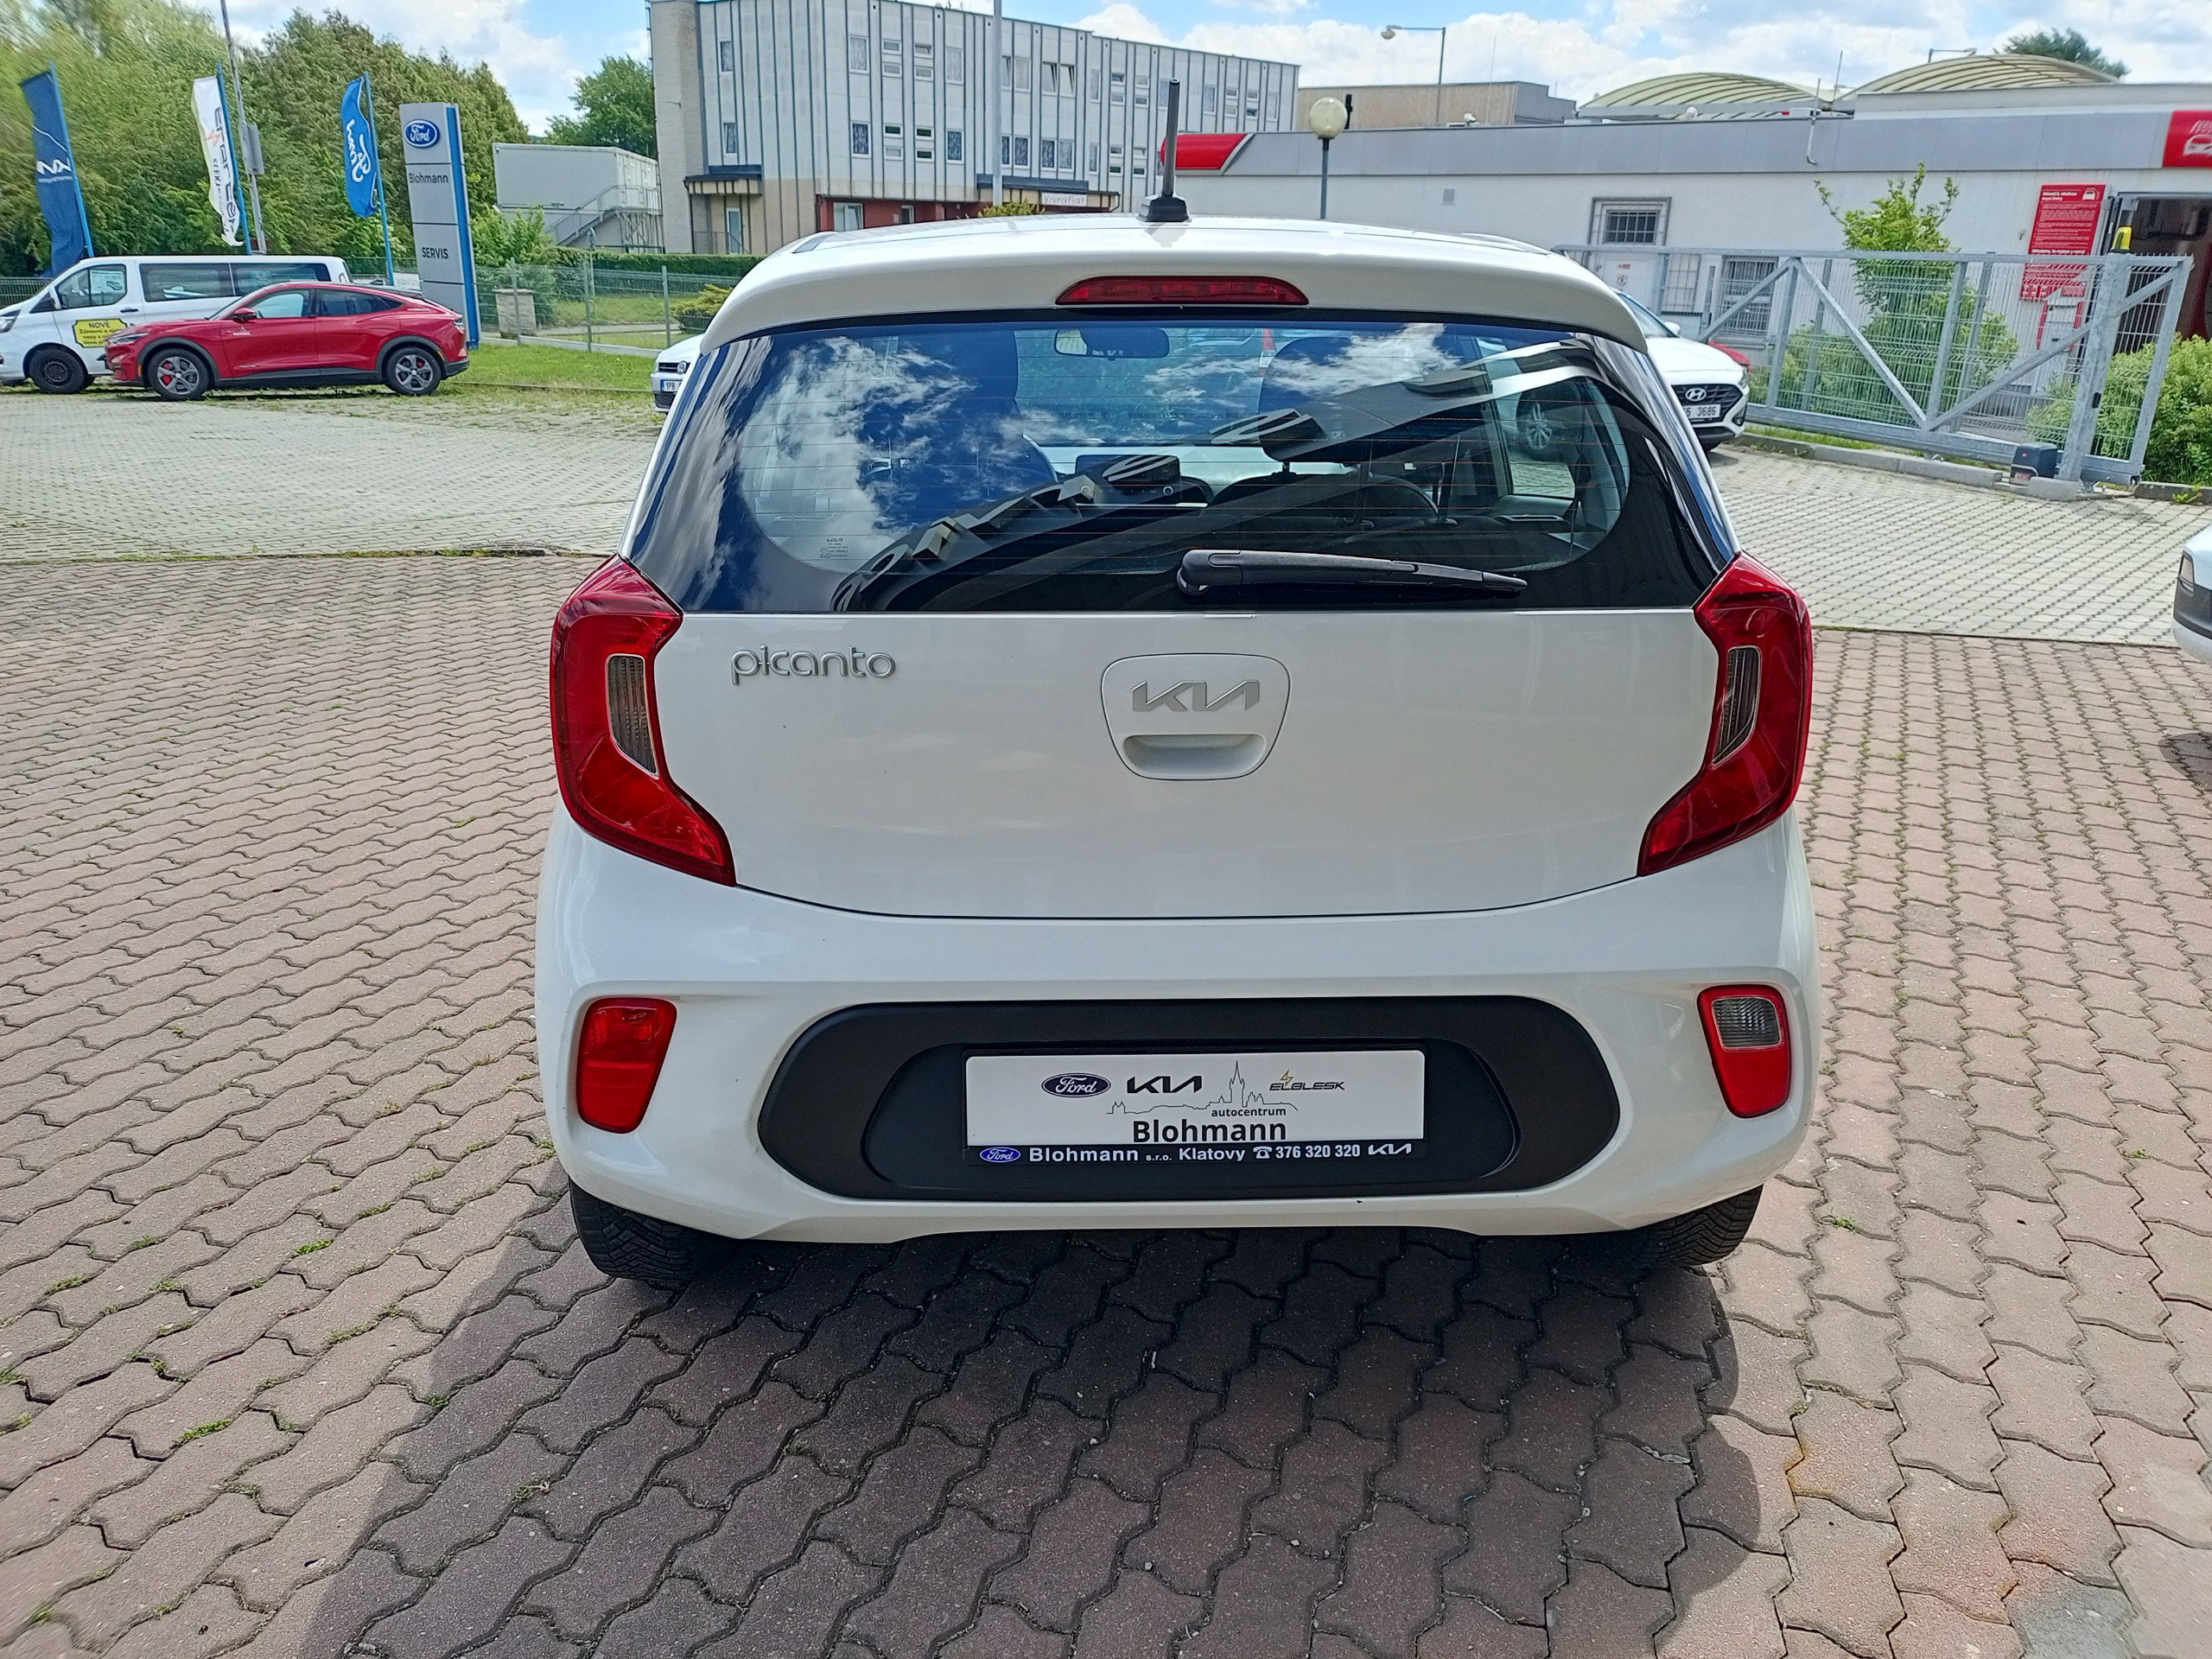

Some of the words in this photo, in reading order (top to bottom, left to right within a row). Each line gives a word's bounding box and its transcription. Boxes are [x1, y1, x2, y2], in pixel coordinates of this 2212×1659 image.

[409, 173, 448, 184] Blohmann
[422, 246, 448, 259] SERVIS
[730, 644, 897, 686] picanto
[1132, 679, 1261, 713] KIA
[1055, 1077, 1097, 1094] Ford
[1127, 1075, 1202, 1094] KIA
[1268, 1080, 1346, 1091] ELBLESK
[1211, 1107, 1287, 1117] autocentrum
[1133, 1119, 1287, 1143] Blohmann
[1029, 1147, 1139, 1163] Blohmann
[1179, 1147, 1246, 1162] Klatovy
[1275, 1146, 1301, 1159] 376
[1305, 1145, 1331, 1159] 320
[1334, 1144, 1361, 1157] 320
[1368, 1143, 1412, 1155] KIA
